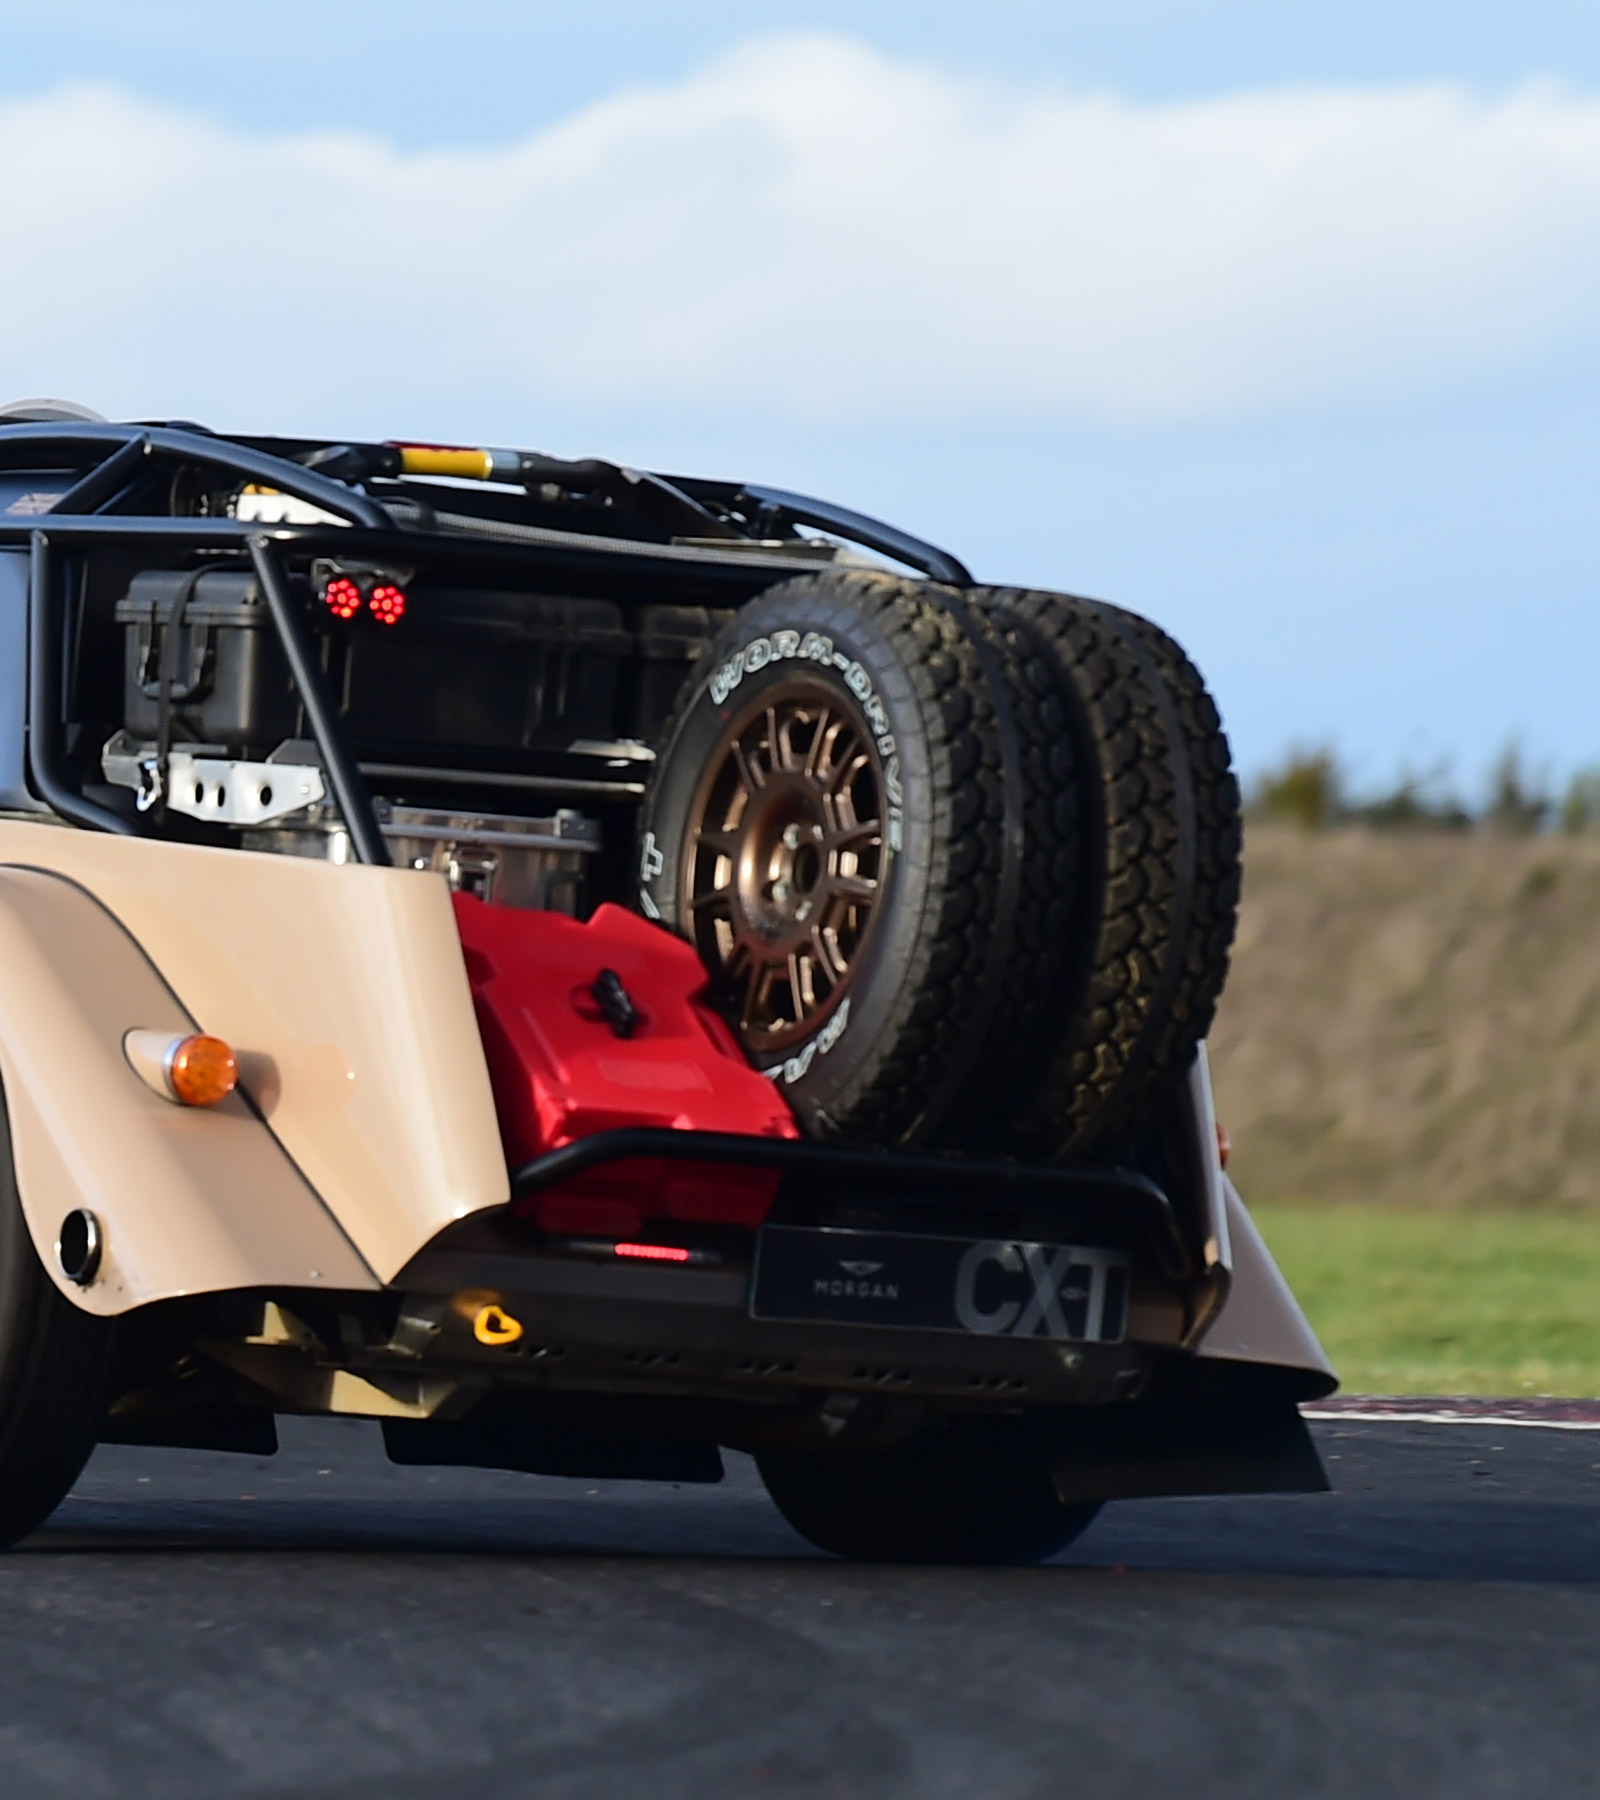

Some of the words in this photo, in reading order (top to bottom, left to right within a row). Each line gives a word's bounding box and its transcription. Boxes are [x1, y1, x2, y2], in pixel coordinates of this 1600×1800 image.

[709, 629, 903, 852] WORM-DRIVE
[813, 1278, 900, 1300] MORGAN
[955, 1240, 1129, 1342] CXT
